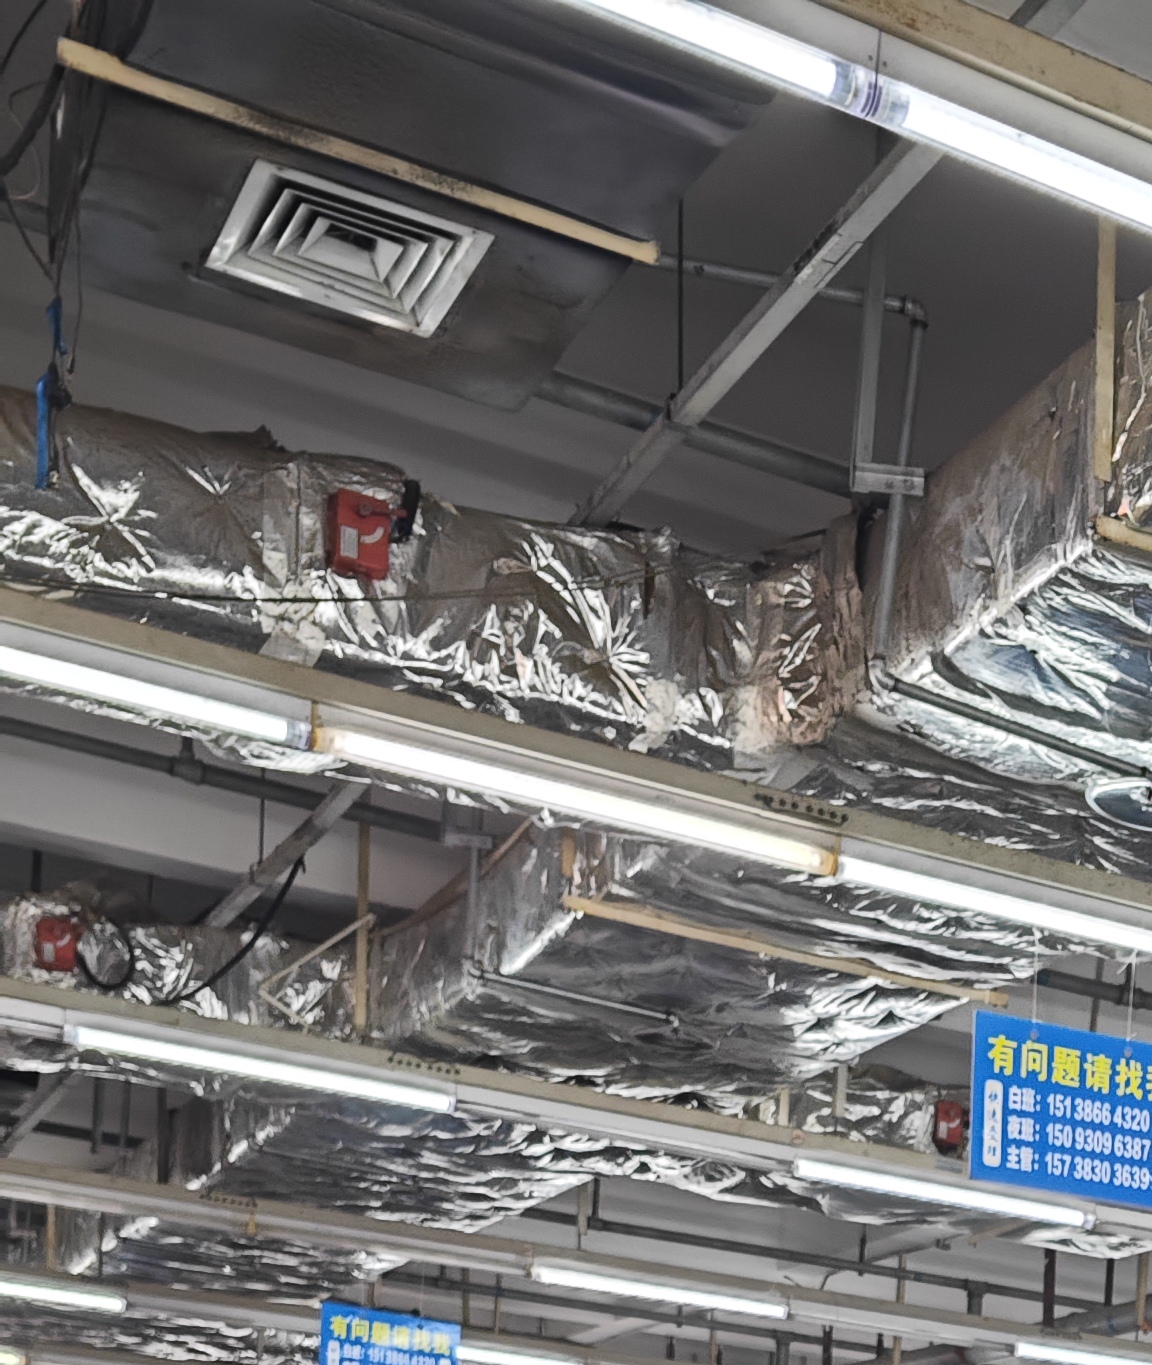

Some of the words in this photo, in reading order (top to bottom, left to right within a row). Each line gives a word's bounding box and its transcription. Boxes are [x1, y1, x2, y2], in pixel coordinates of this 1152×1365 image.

[1047, 1093, 1072, 1119] 151
[1074, 1097, 1111, 1126] 3866
[1113, 1105, 1150, 1133] 4320
[1046, 1122, 1073, 1148] 150
[1075, 1127, 1112, 1155] 9309
[1114, 1133, 1152, 1161] 6387
[1045, 1151, 1072, 1178] 157
[1074, 1156, 1111, 1184] 3830
[1113, 1162, 1150, 1190] 3639
